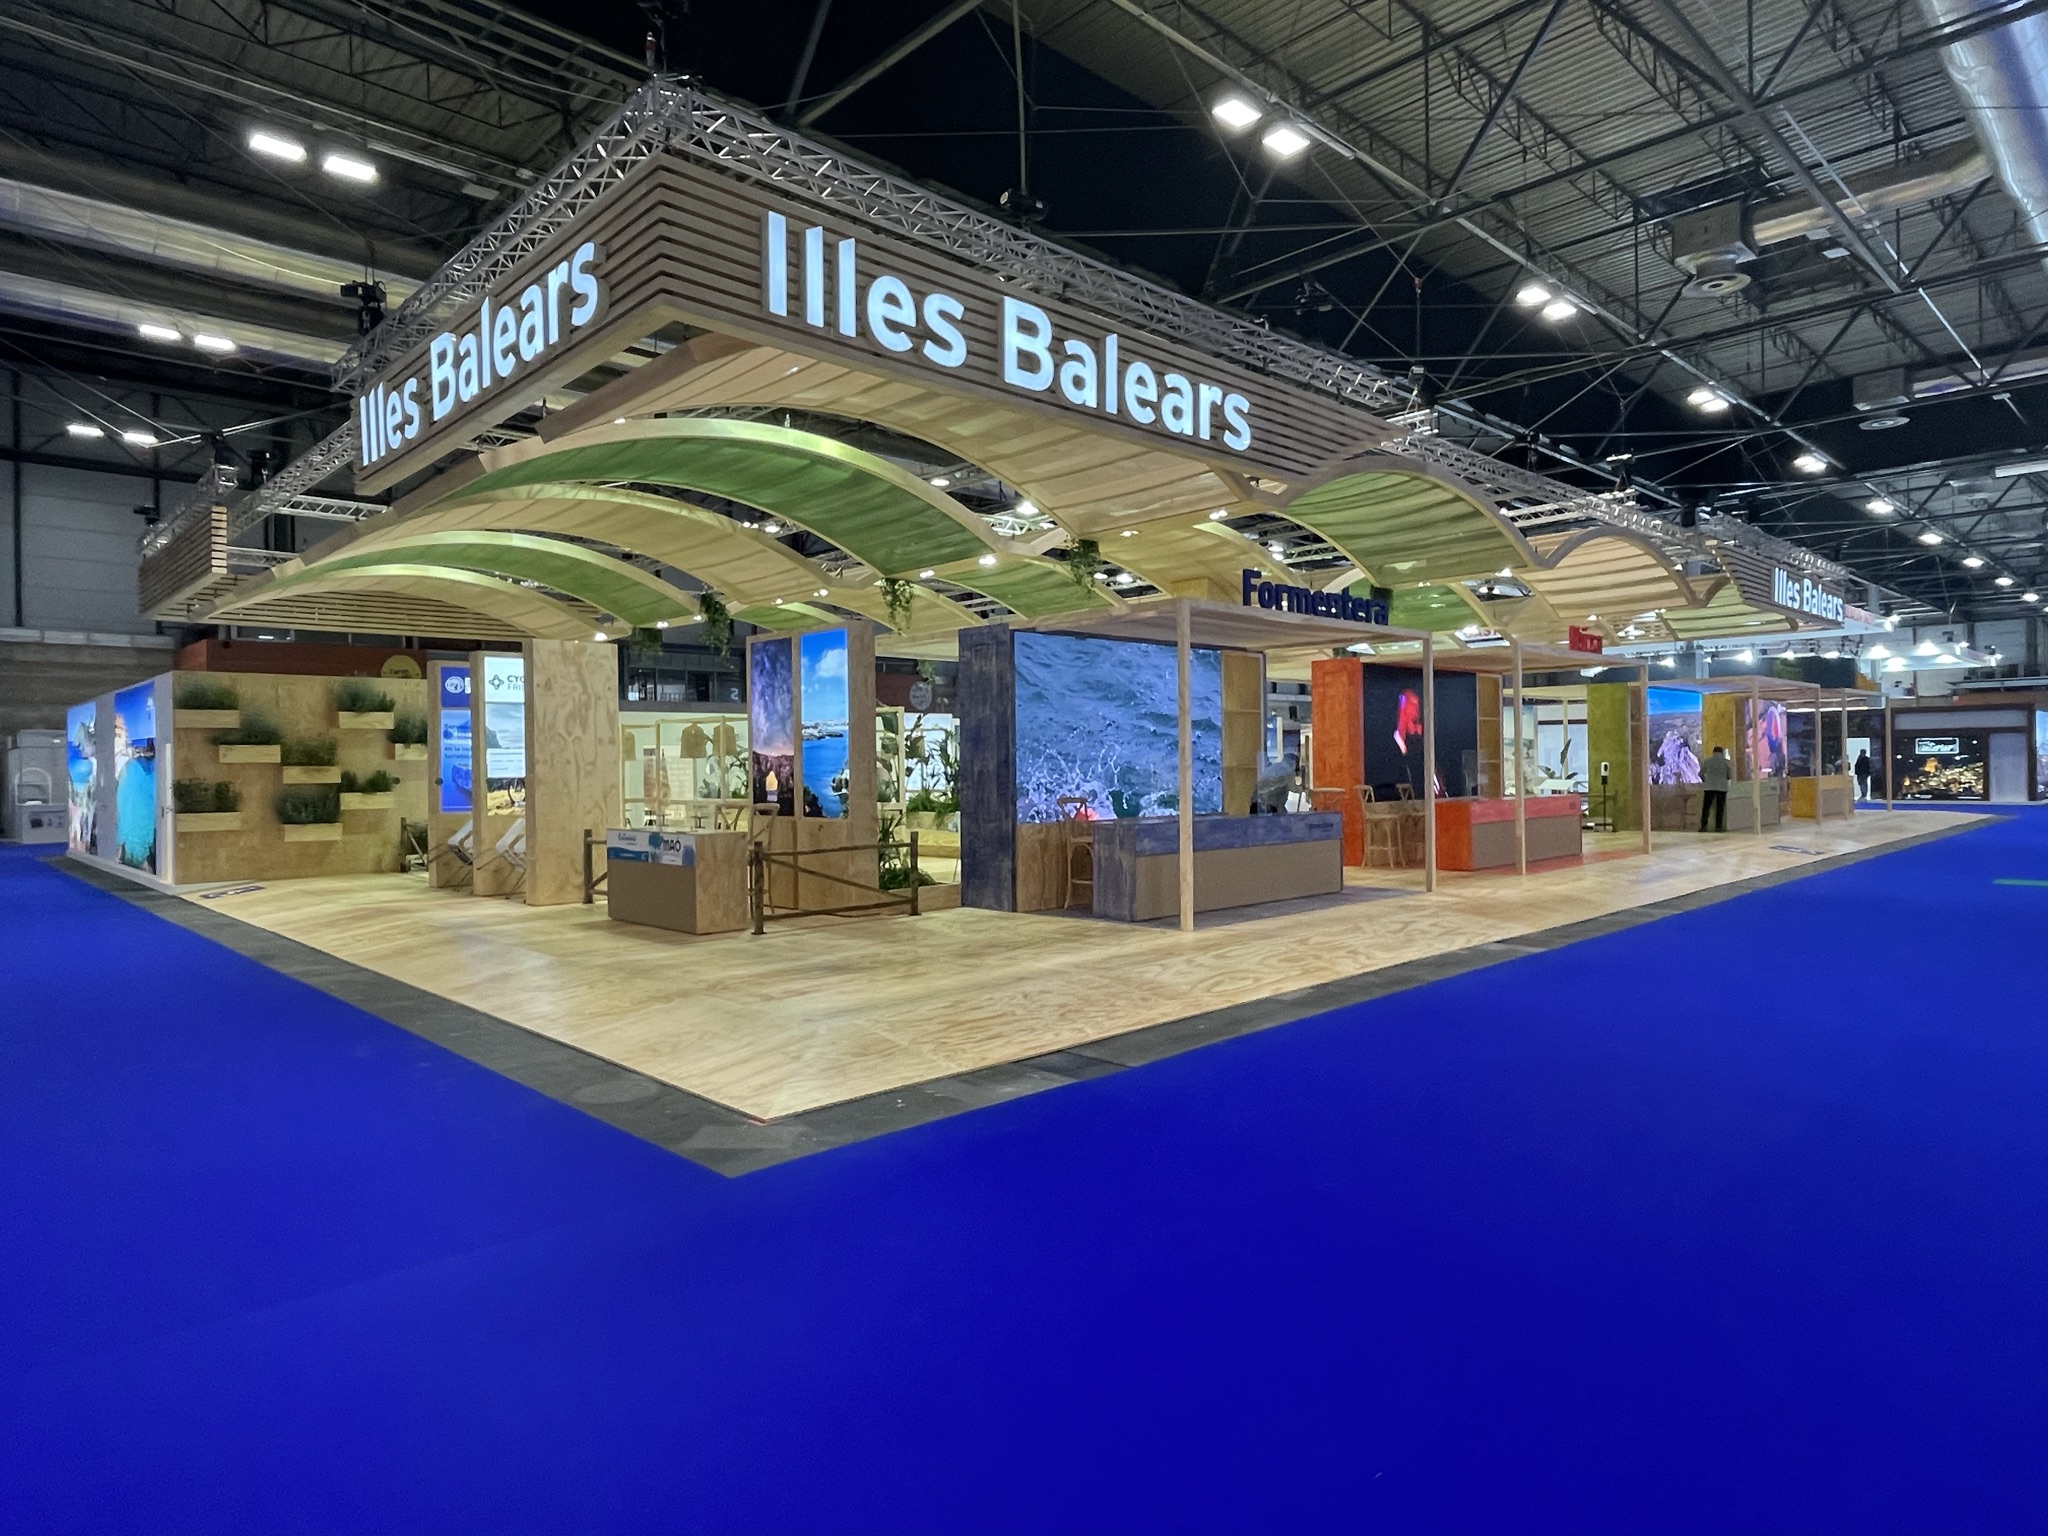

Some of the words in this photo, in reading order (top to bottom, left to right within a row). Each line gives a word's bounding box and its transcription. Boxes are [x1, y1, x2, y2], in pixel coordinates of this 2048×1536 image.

[359, 376, 421, 467] Illes
[430, 241, 599, 421] Balears
[768, 211, 968, 367] Illes
[1003, 295, 1252, 452] Balears
[1774, 566, 1800, 610] Illes
[1803, 578, 1844, 622] Balears
